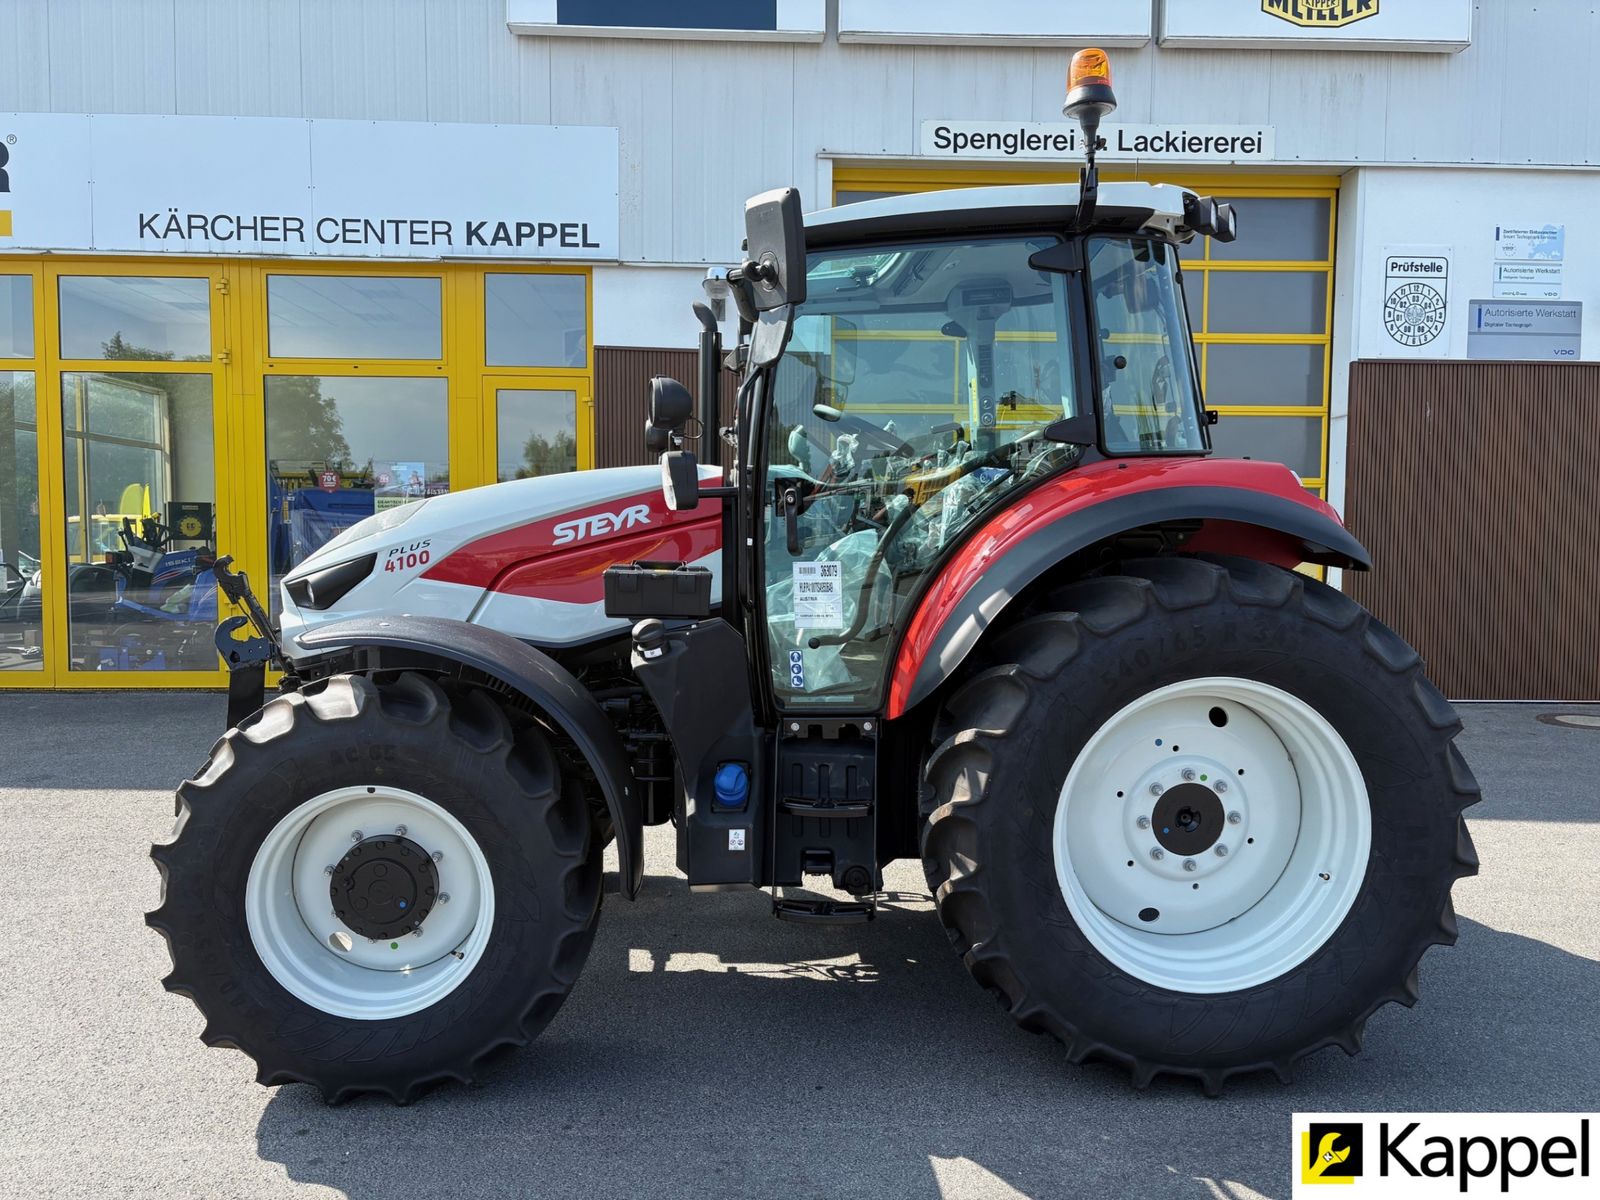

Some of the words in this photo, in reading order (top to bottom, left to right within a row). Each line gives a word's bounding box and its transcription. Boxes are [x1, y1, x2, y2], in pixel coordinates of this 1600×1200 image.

[933, 126, 1075, 155] Spenglerei
[1118, 129, 1263, 154] Lackiererei
[139, 208, 304, 243] KÄRCHER
[317, 218, 453, 246] CENTER
[465, 222, 600, 249] KAPPEL
[1390, 261, 1443, 274] Prüfstelle
[1484, 308, 1533, 317] Autorisierte
[1535, 308, 1577, 318] Werkstatt
[552, 504, 651, 546] STEYR
[388, 538, 432, 557] PLUS
[384, 550, 430, 573] 4100
